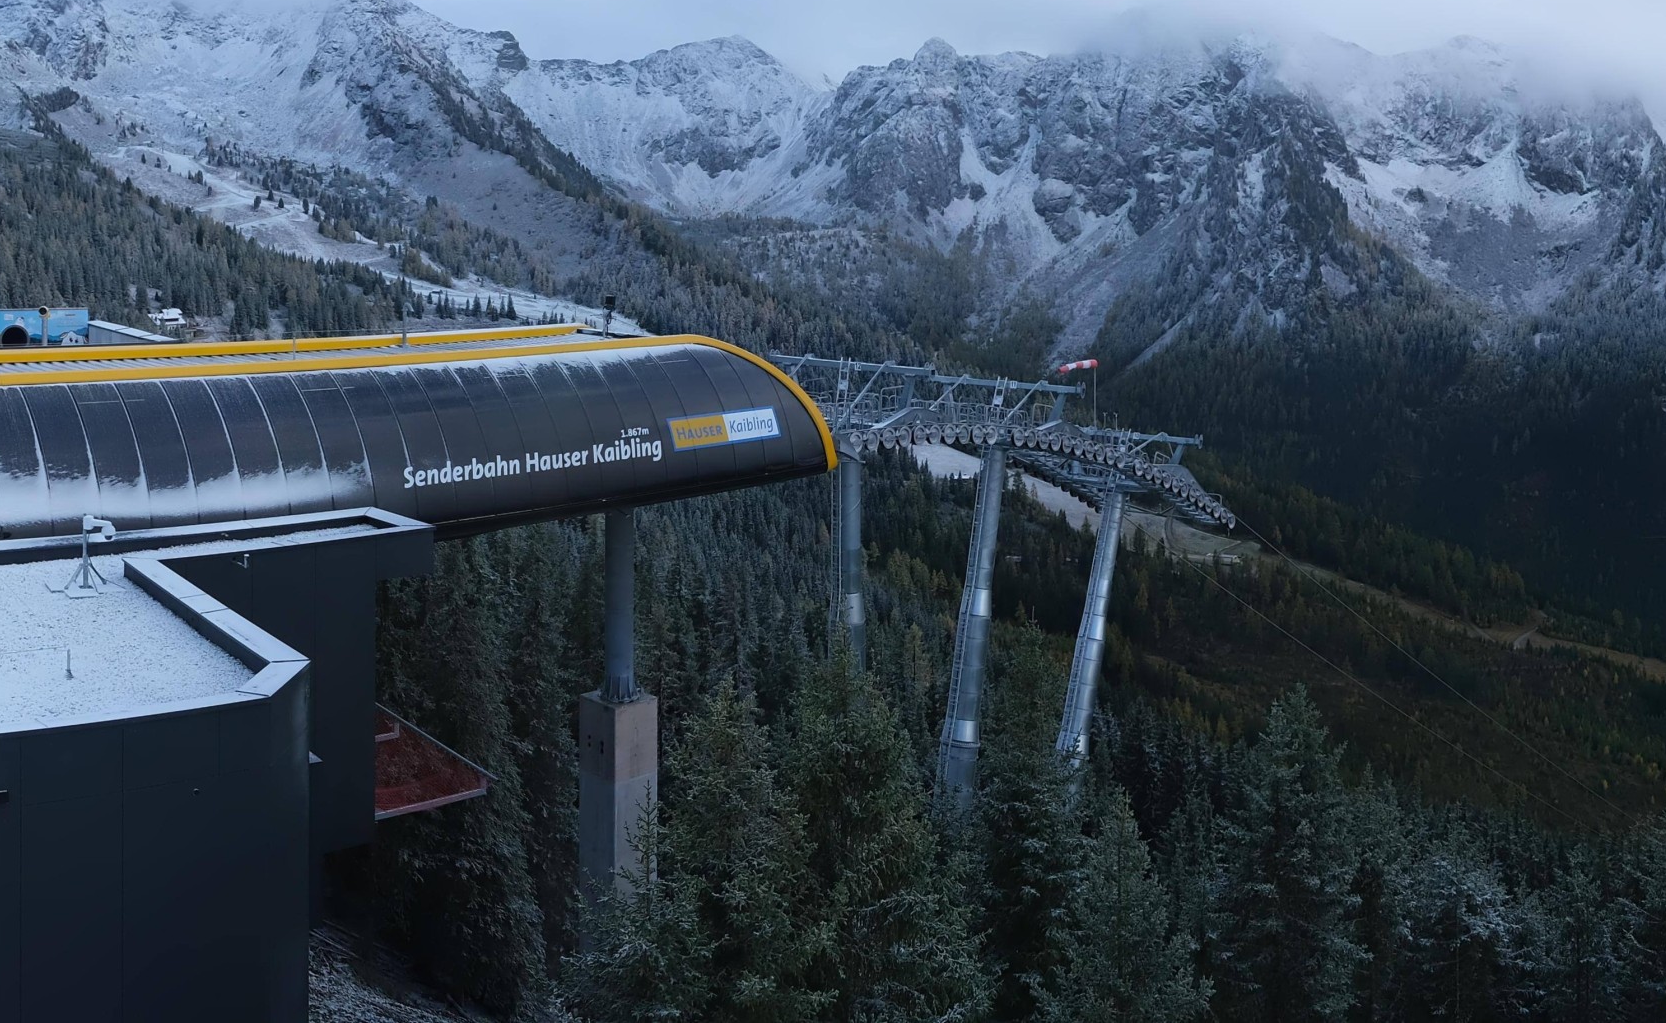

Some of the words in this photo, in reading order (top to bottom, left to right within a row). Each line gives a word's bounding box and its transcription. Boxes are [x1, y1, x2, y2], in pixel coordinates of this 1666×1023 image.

[620, 427, 650, 438] 1.867m
[676, 425, 723, 441] HAUSER
[729, 417, 773, 433] Kaibling
[403, 454, 520, 488] Senderbahn
[525, 450, 589, 473] Hauser
[592, 439, 663, 463] Kaibling
